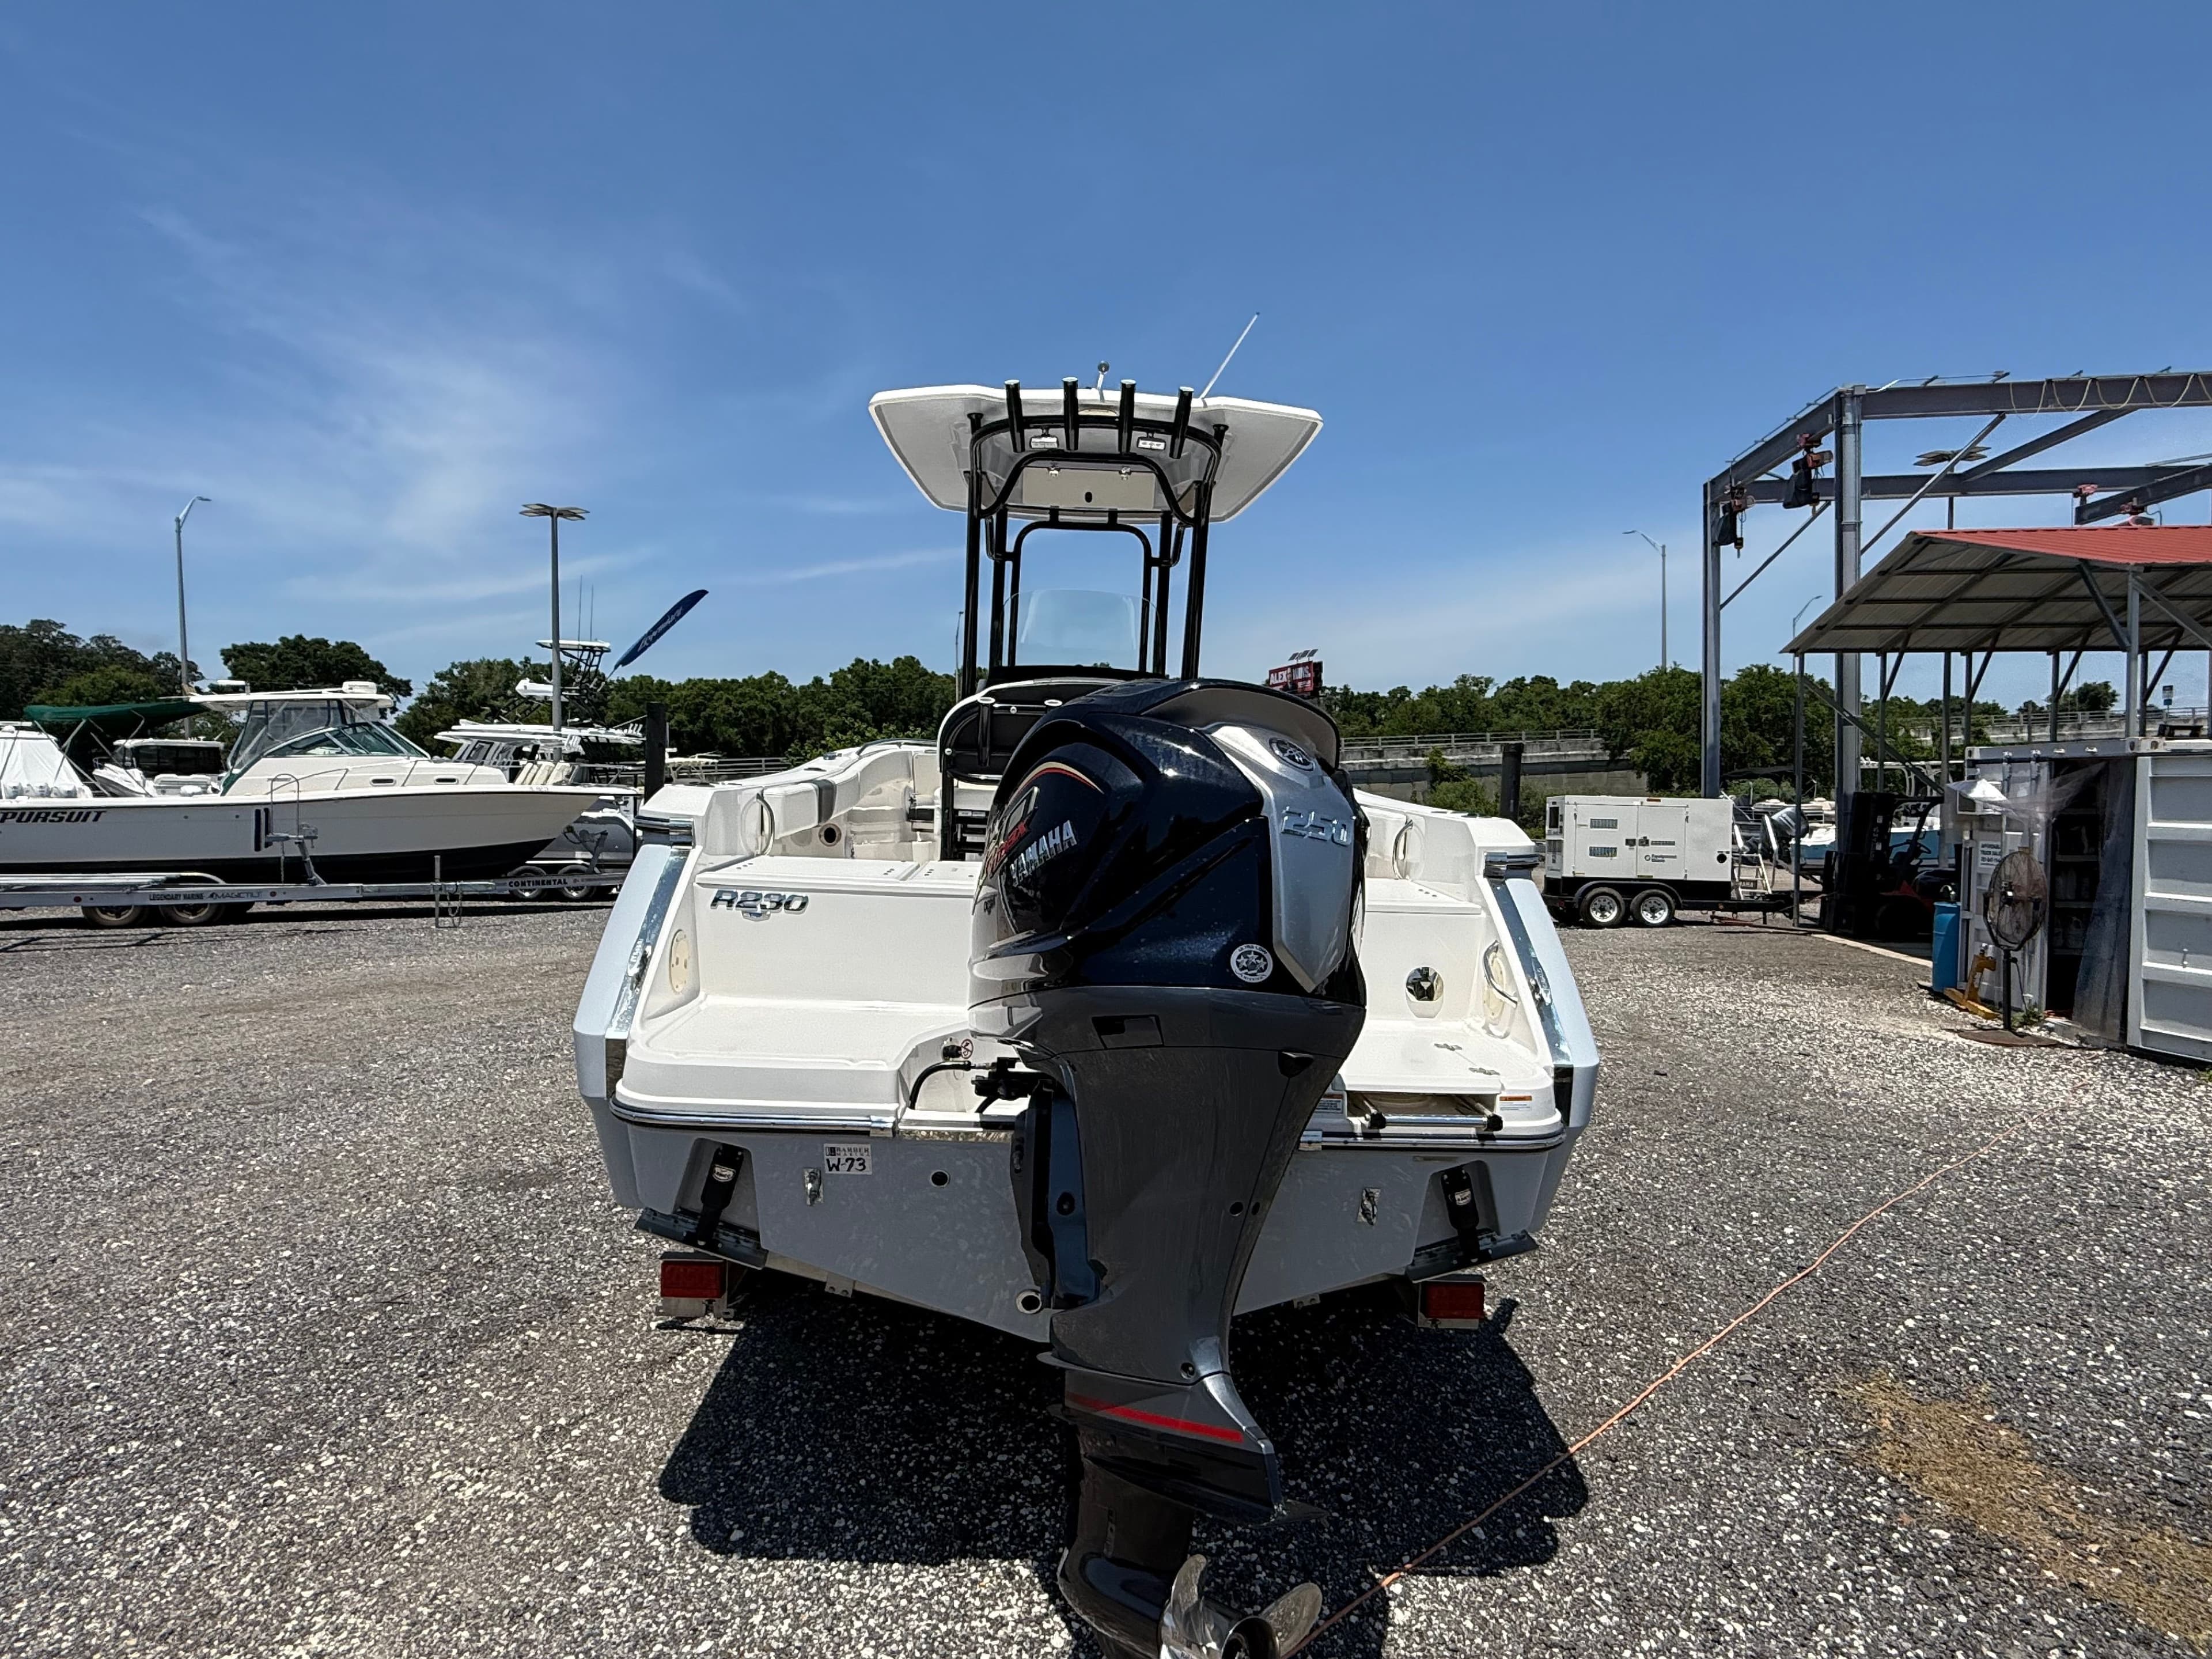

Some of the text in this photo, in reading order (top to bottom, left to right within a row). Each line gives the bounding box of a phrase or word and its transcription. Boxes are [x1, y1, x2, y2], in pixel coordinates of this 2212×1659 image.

[1270, 670, 1287, 685] ALEX
[0, 810, 107, 823] PURSUIT
[1282, 806, 1353, 847] 250
[1010, 820, 1077, 887] YAMAHA
[508, 878, 567, 887] CONTINENTAL
[710, 889, 809, 915] R230
[825, 1157, 866, 1172] W-73
